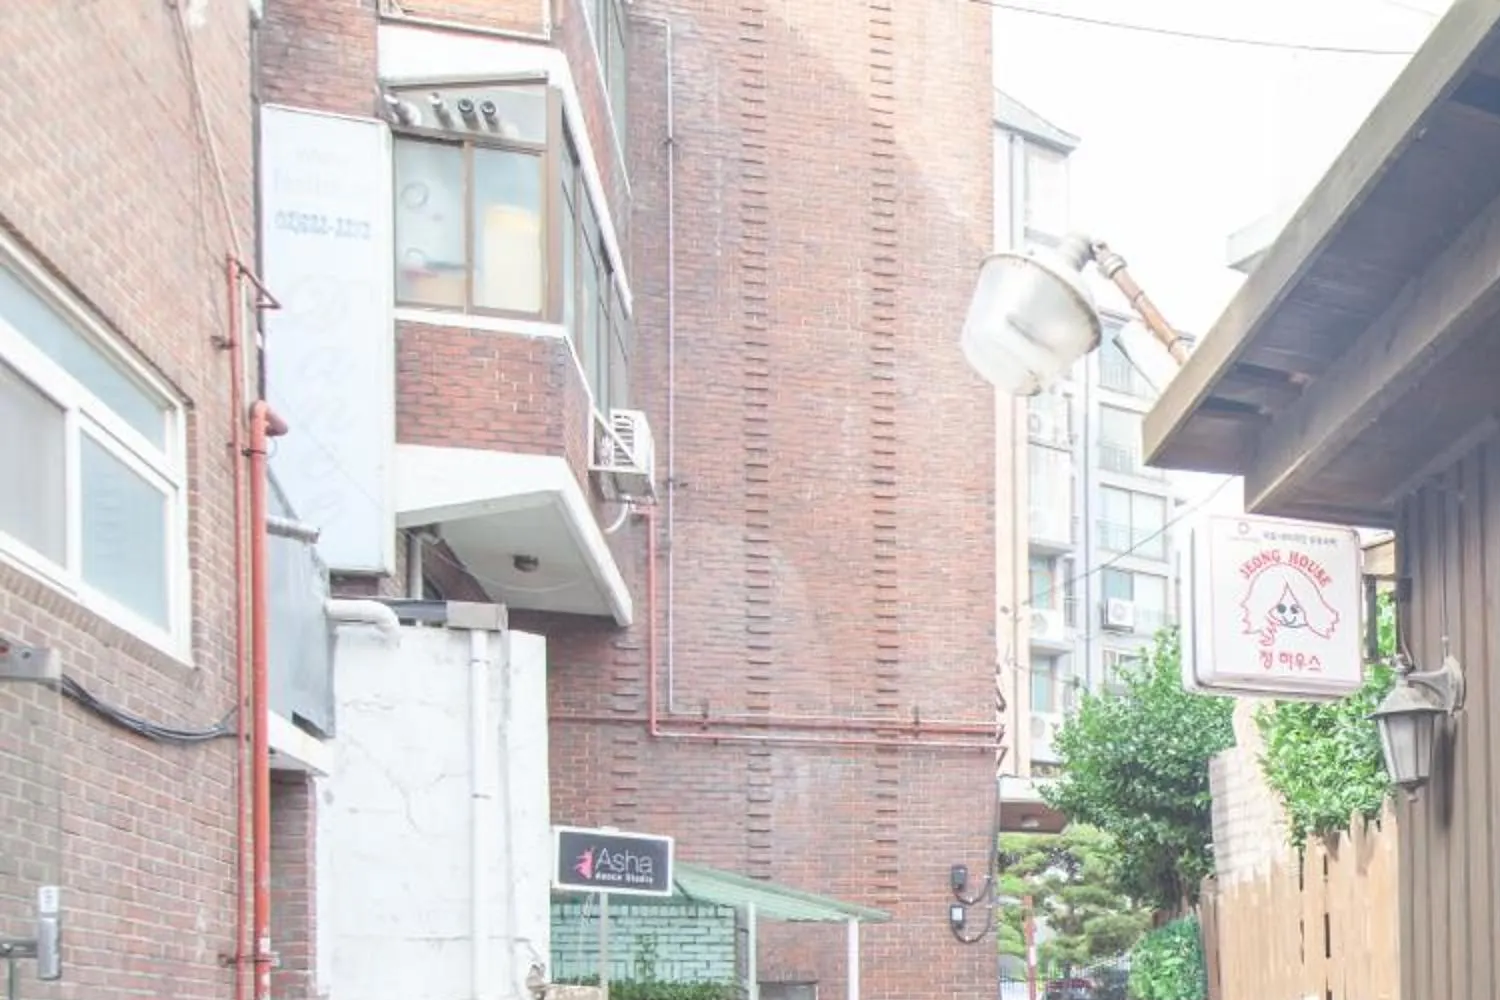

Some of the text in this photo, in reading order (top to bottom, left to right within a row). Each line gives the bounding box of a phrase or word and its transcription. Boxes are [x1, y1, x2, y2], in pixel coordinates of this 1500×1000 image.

[1240, 549, 1332, 588] JEONG HOUSE
[595, 847, 653, 874] Asha
